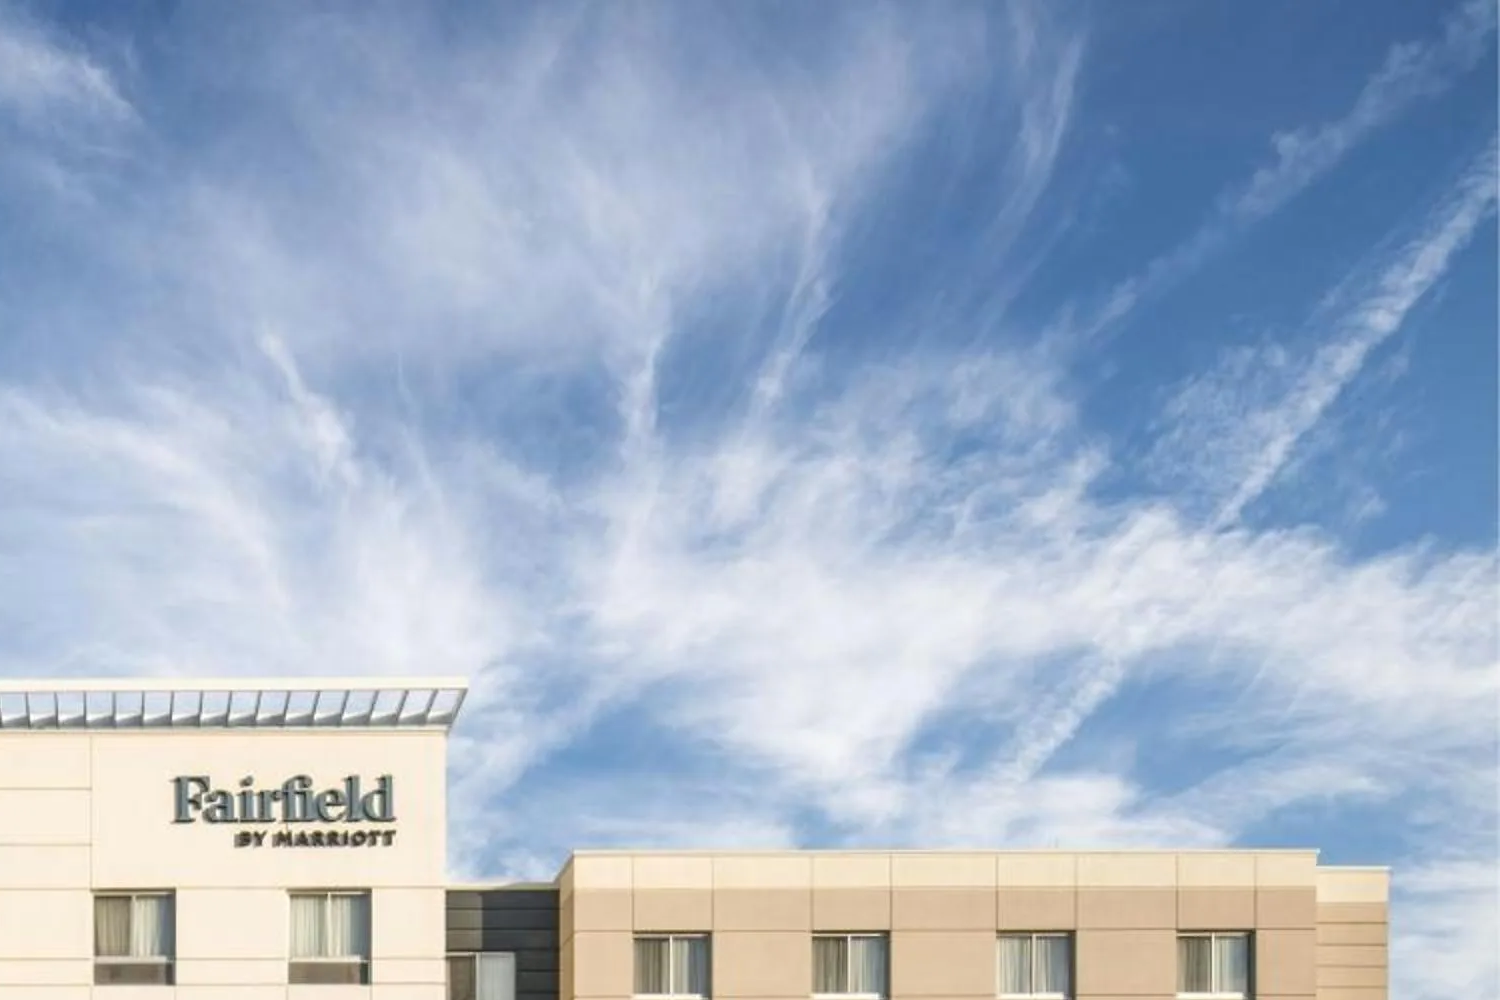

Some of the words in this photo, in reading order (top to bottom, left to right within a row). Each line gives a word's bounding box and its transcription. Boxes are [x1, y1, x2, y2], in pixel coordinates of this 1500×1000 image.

[171, 774, 397, 825] Fairfield
[234, 829, 267, 848] BY
[271, 829, 397, 848] MARRIOTT
